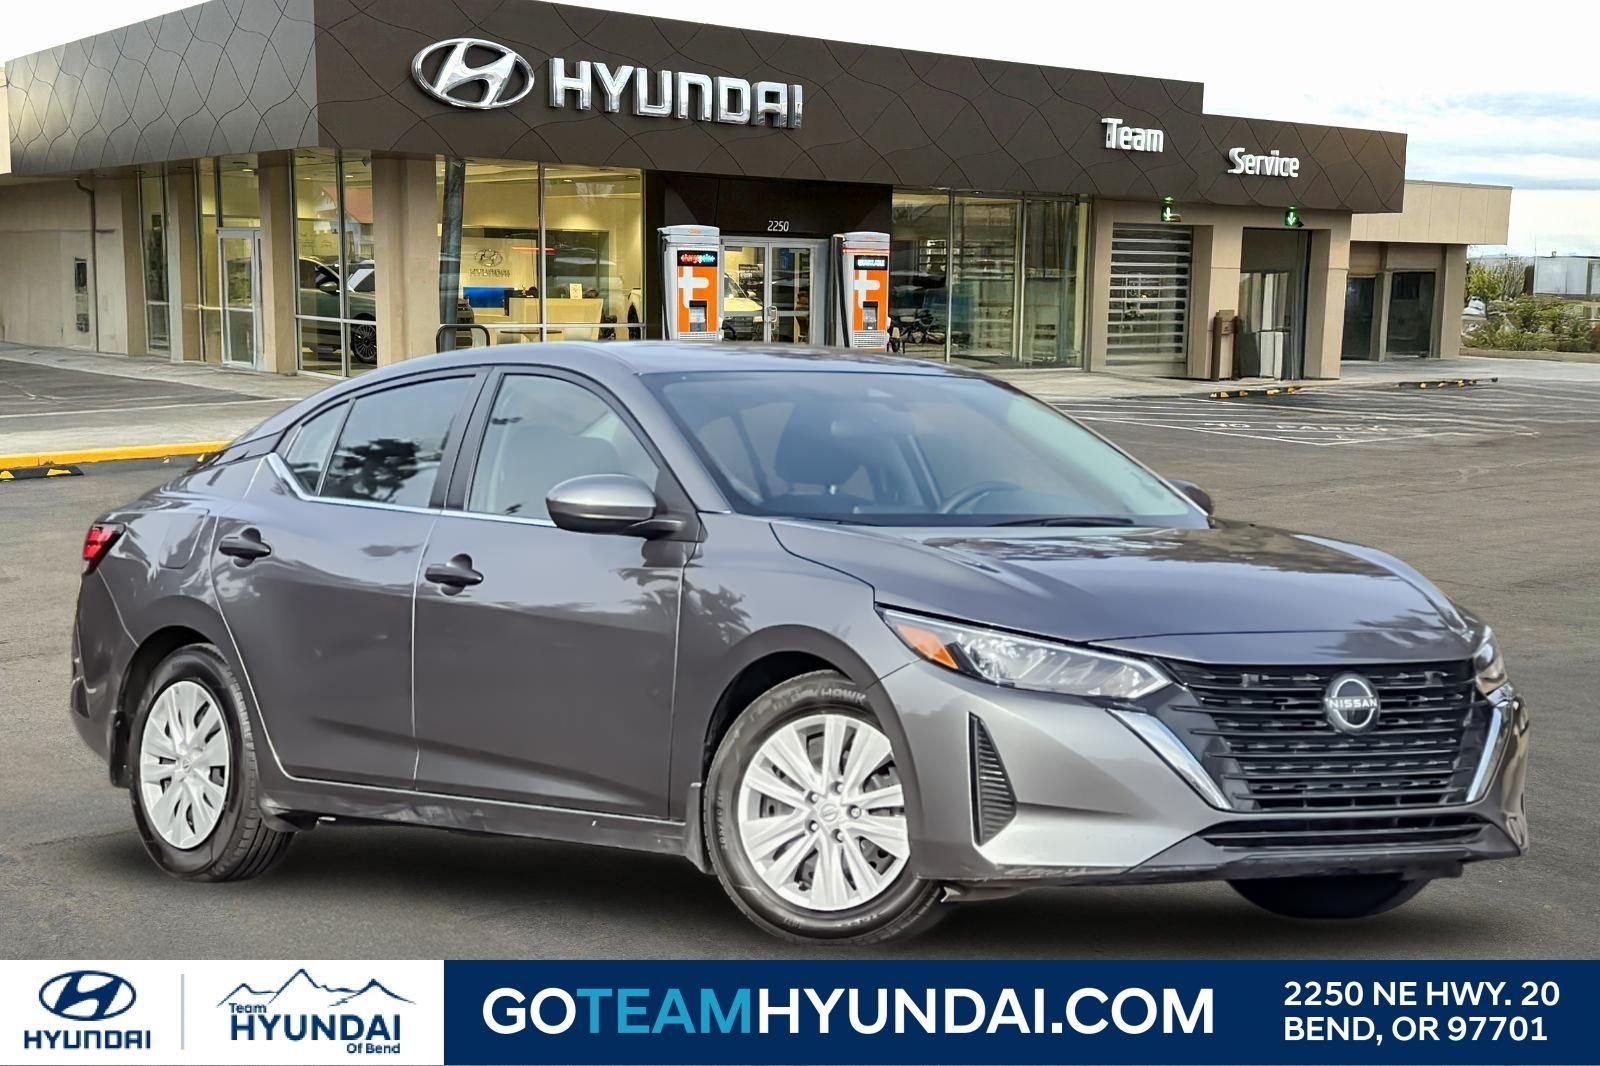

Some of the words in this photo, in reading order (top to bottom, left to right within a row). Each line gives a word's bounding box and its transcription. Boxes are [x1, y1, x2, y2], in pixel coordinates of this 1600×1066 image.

[549, 57, 804, 129] HYUNDAI
[1101, 117, 1165, 153] Team
[1227, 147, 1301, 178] Service
[767, 220, 790, 232] 2250
[1328, 698, 1378, 709] NISSAN
